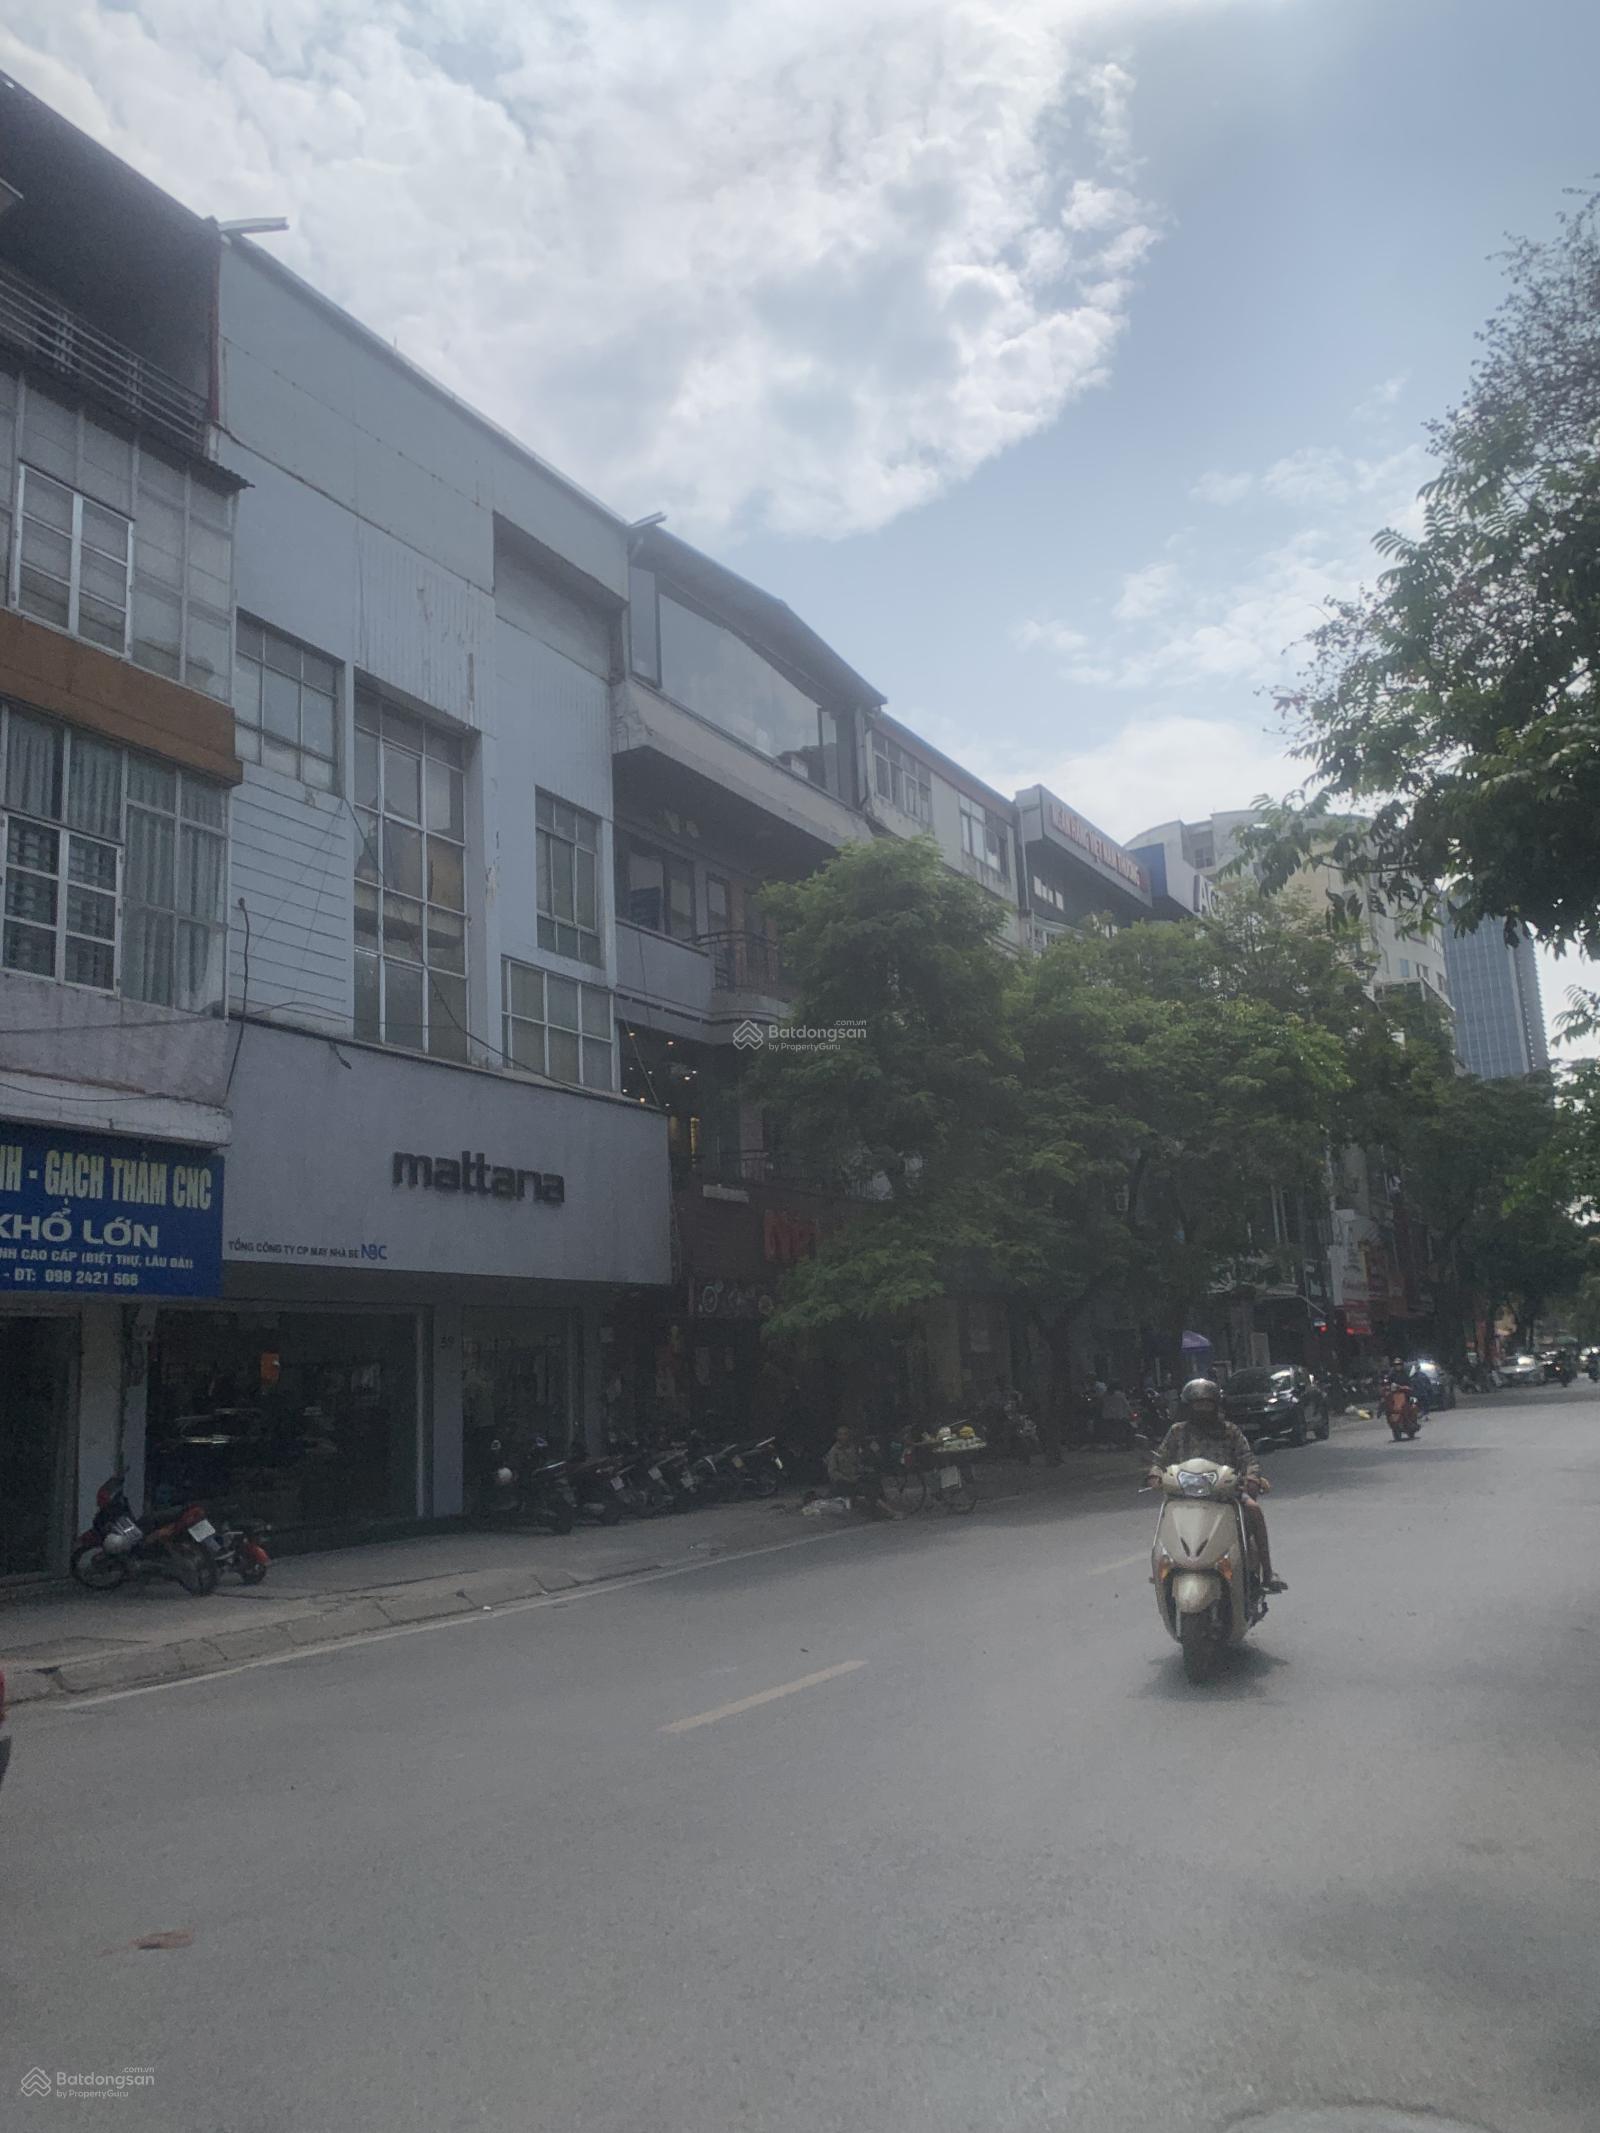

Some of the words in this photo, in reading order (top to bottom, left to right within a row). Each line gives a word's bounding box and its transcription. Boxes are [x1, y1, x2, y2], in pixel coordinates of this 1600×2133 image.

[172, 1165, 212, 1211] CNC
[391, 1150, 566, 1203] mattana
[82, 1216, 159, 1249] LỚN
[21, 1248, 48, 1262] CAO
[284, 1244, 296, 1255] TY
[360, 1243, 388, 1260] NBC
[45, 1269, 72, 1283] 098
[75, 1271, 109, 1285] 2421
